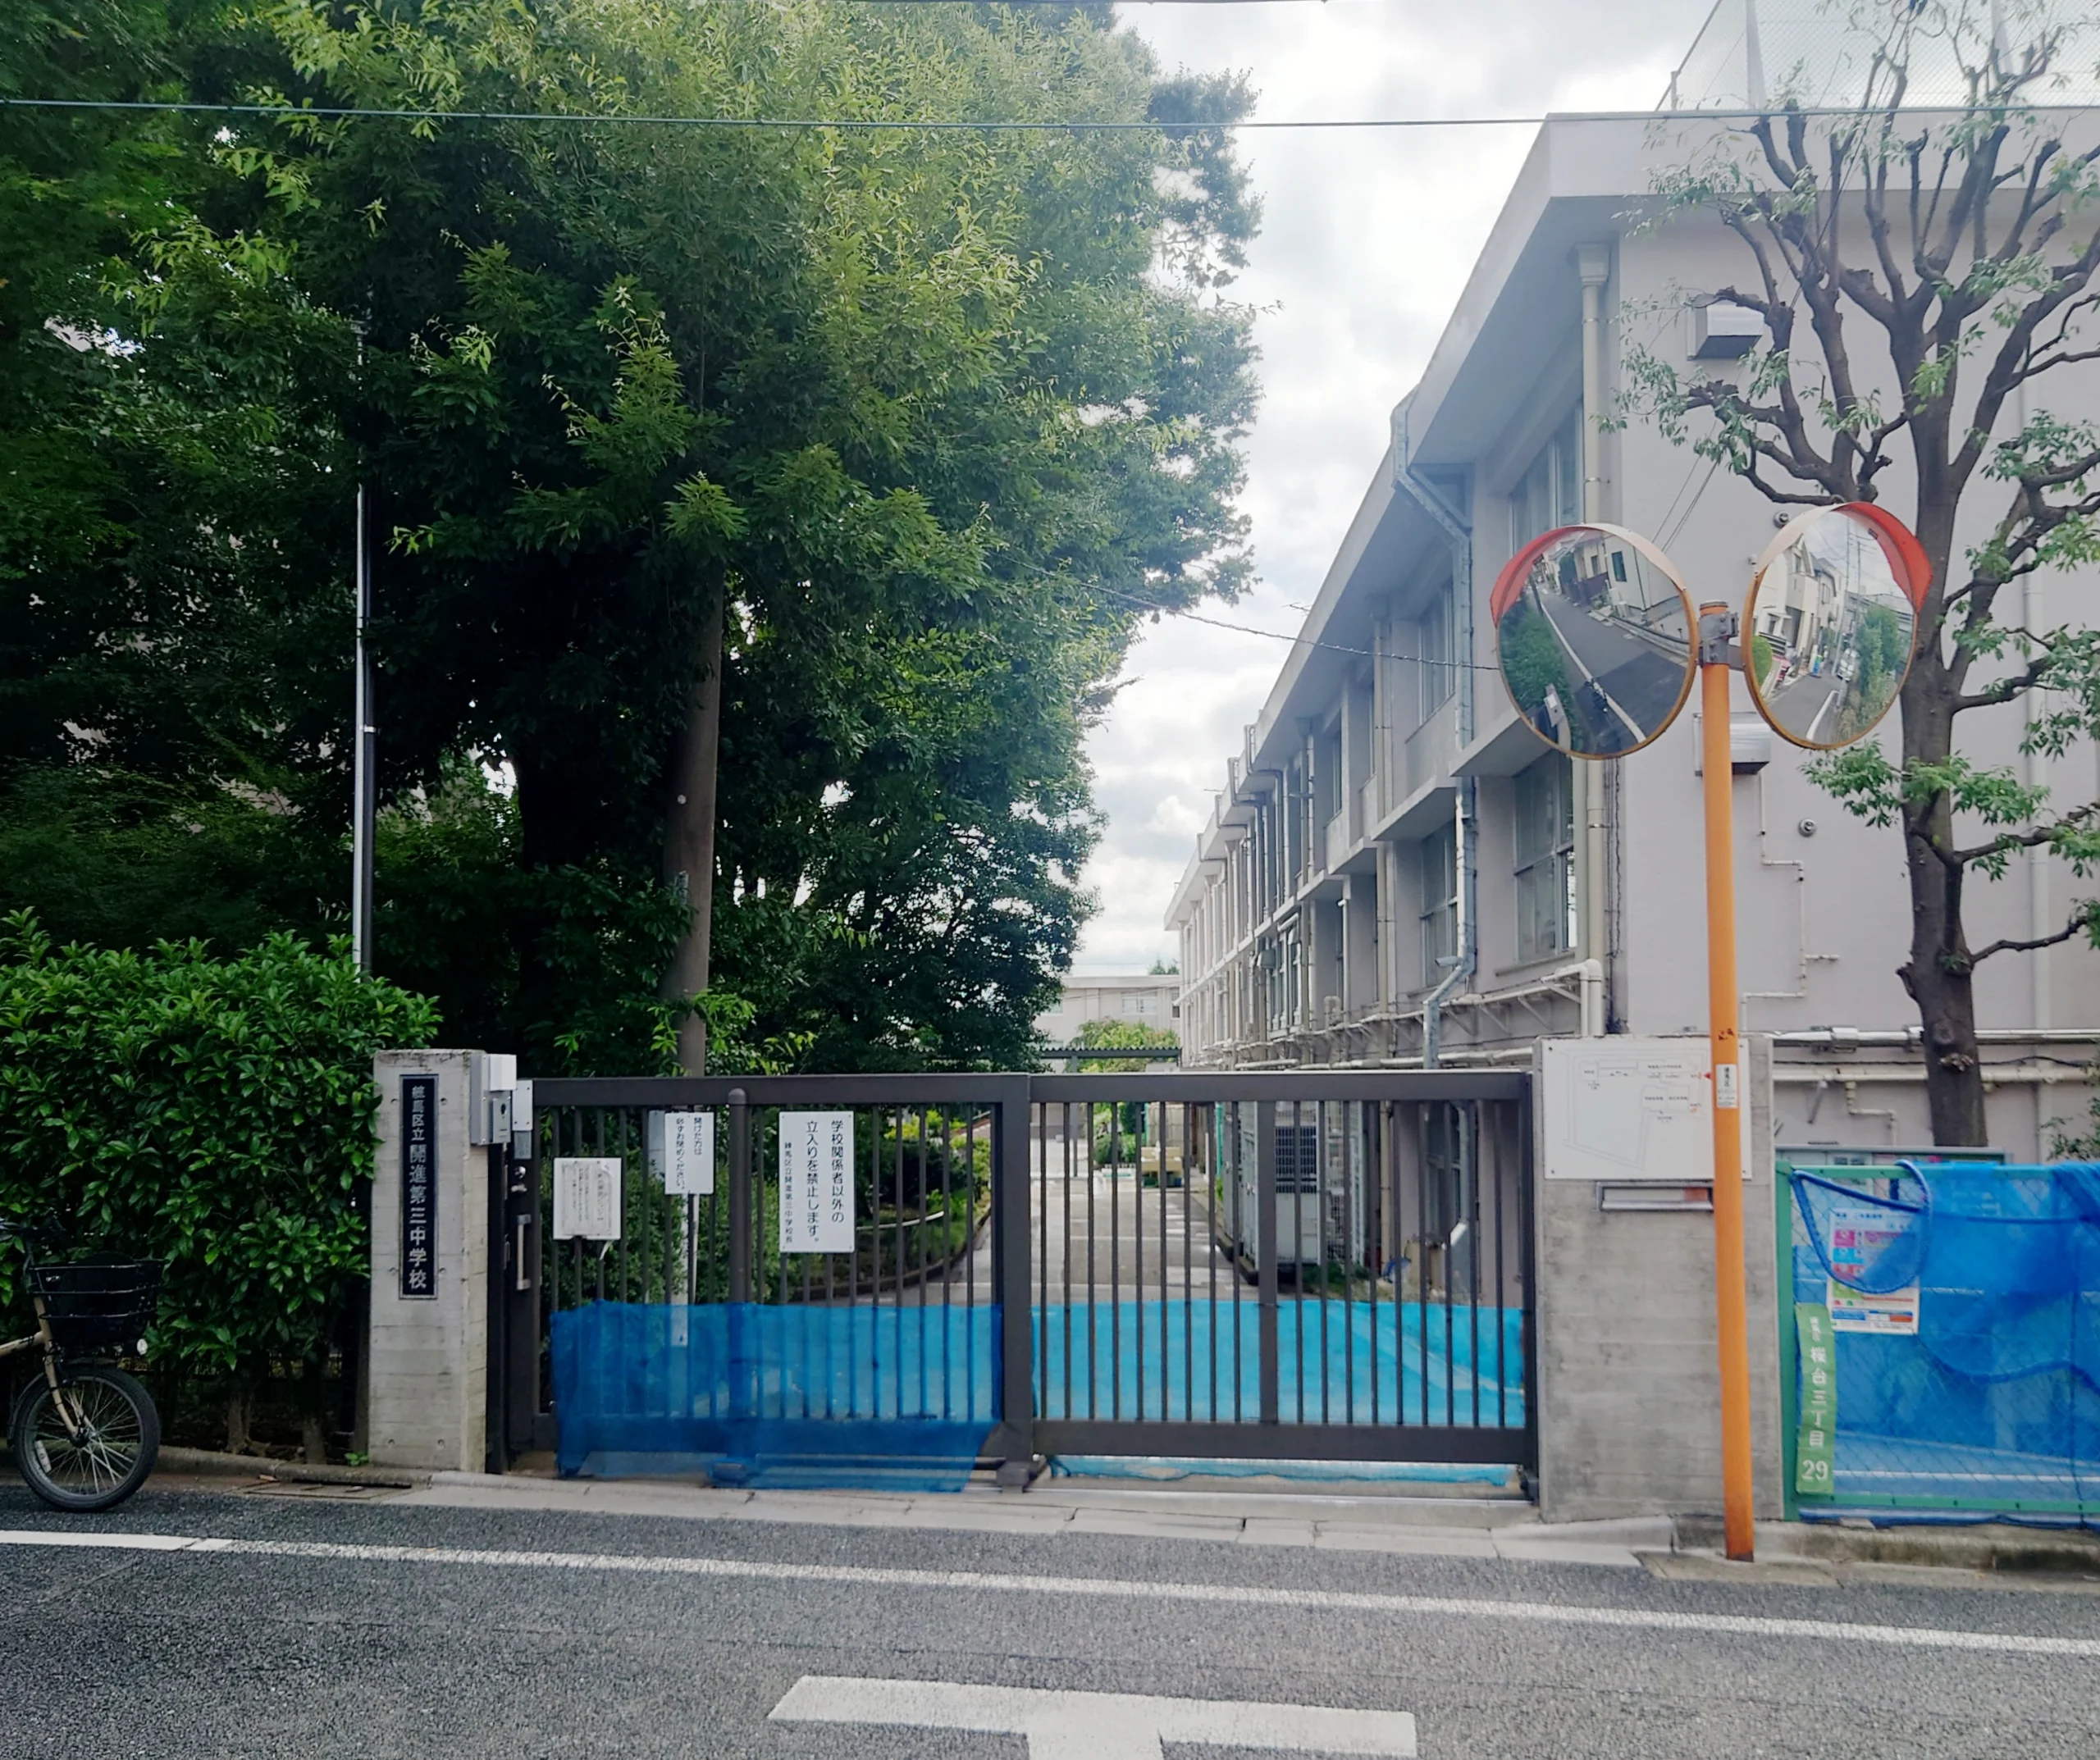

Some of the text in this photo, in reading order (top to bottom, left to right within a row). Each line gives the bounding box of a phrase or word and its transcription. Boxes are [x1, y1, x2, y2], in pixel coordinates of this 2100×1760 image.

[806, 1120, 819, 1242] 立入りを禁止します。
[831, 1119, 844, 1224] 学校関係者以外の
[1801, 1459, 1829, 1481] 29
